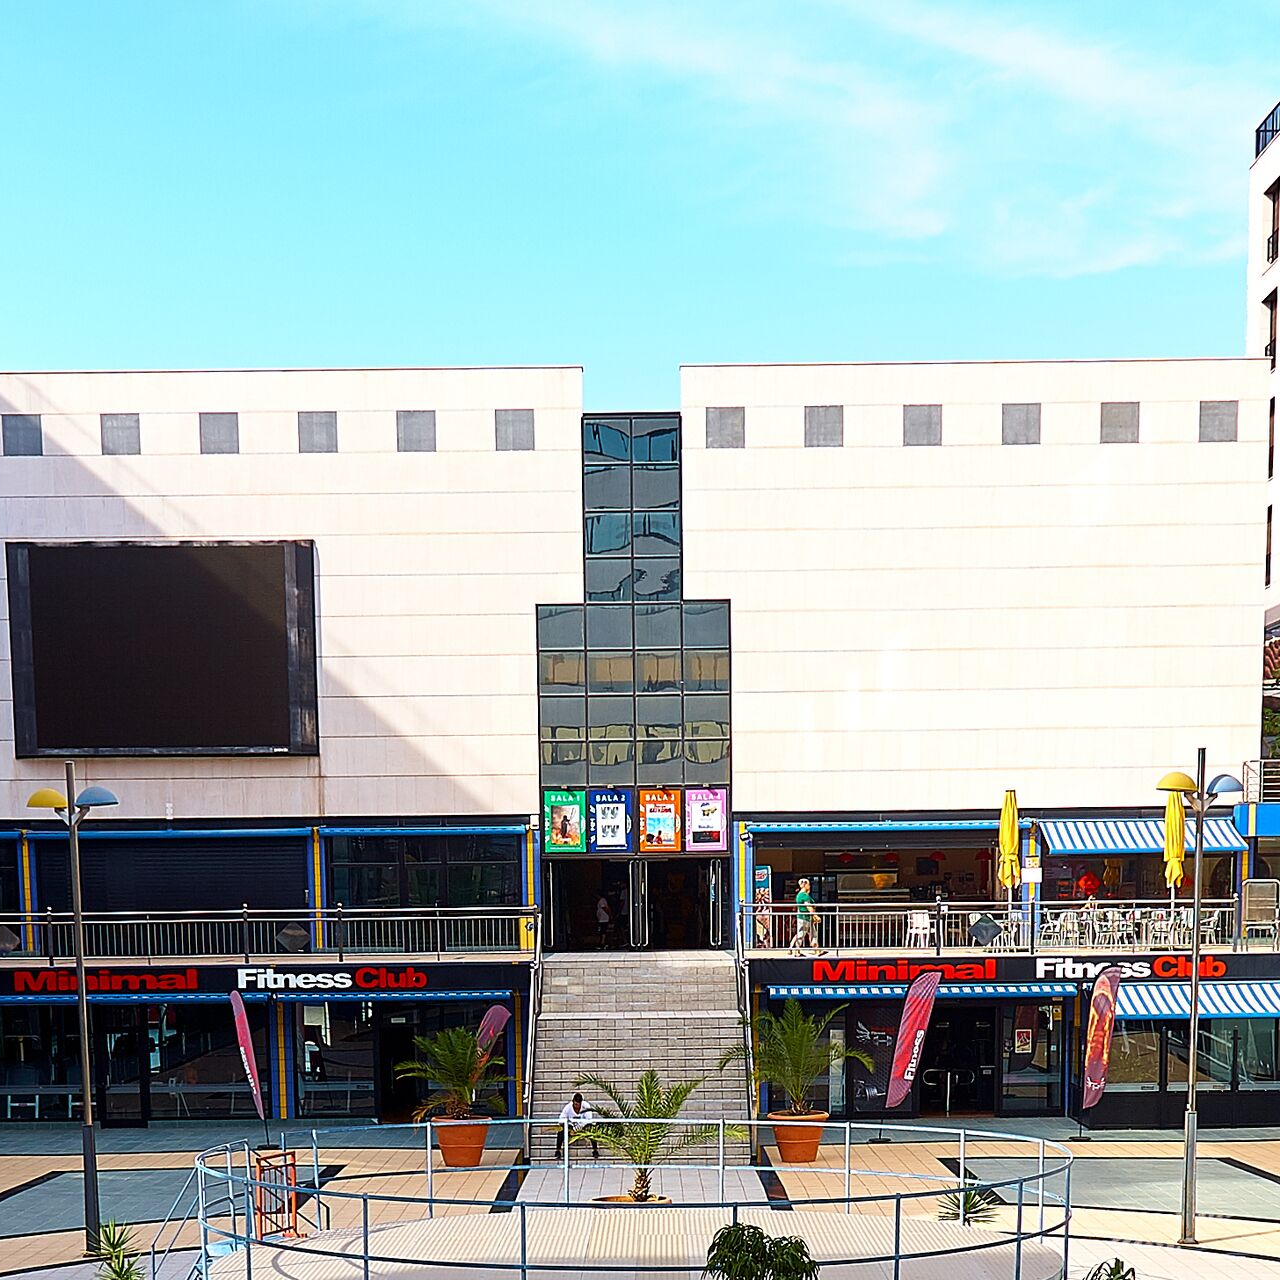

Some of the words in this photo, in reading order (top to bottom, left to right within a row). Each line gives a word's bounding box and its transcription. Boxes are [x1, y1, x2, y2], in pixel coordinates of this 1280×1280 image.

[550, 794, 574, 802] SALA
[595, 794, 619, 802] SALA
[645, 793, 669, 802] SALA
[237, 968, 353, 989] Fitness
[354, 966, 428, 989] Club
[812, 958, 997, 982] Minimal
[1152, 955, 1227, 978] Club
[13, 968, 198, 993] Minimal
